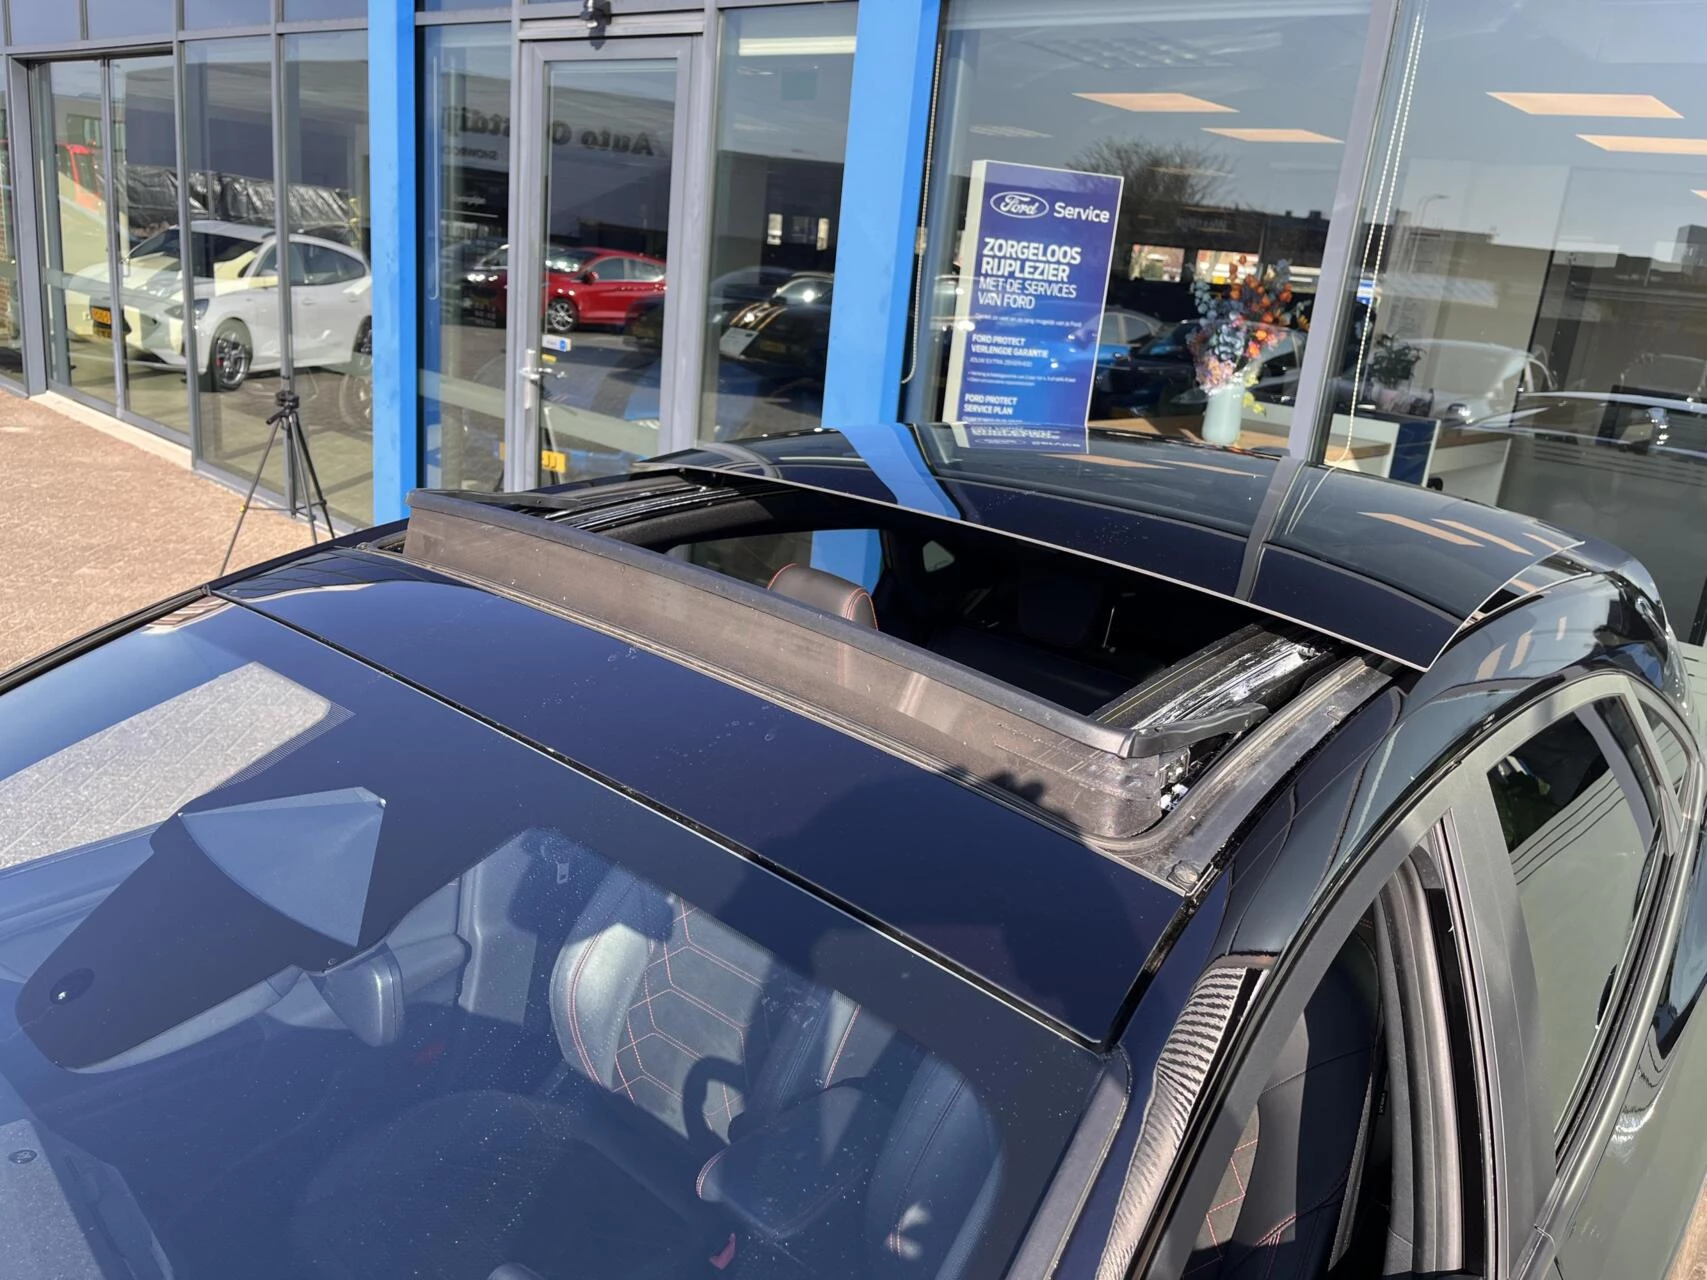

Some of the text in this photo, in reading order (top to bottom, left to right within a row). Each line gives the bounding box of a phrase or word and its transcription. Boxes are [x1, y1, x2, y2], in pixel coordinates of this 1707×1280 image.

[998, 194, 1110, 223] Ford Service
[982, 237, 1082, 265] ZORGELOOS
[980, 257, 1070, 282] RIJPLEZIER
[979, 276, 1077, 298] MET DE SERVICES
[978, 291, 1036, 309] VAN FORD
[972, 334, 1026, 346] FORD PROTECT
[971, 344, 1049, 358] VERLENGDE GARANTIE
[965, 393, 1018, 406] FORD PROTECT
[963, 403, 1014, 416] SERVICE PLAN
